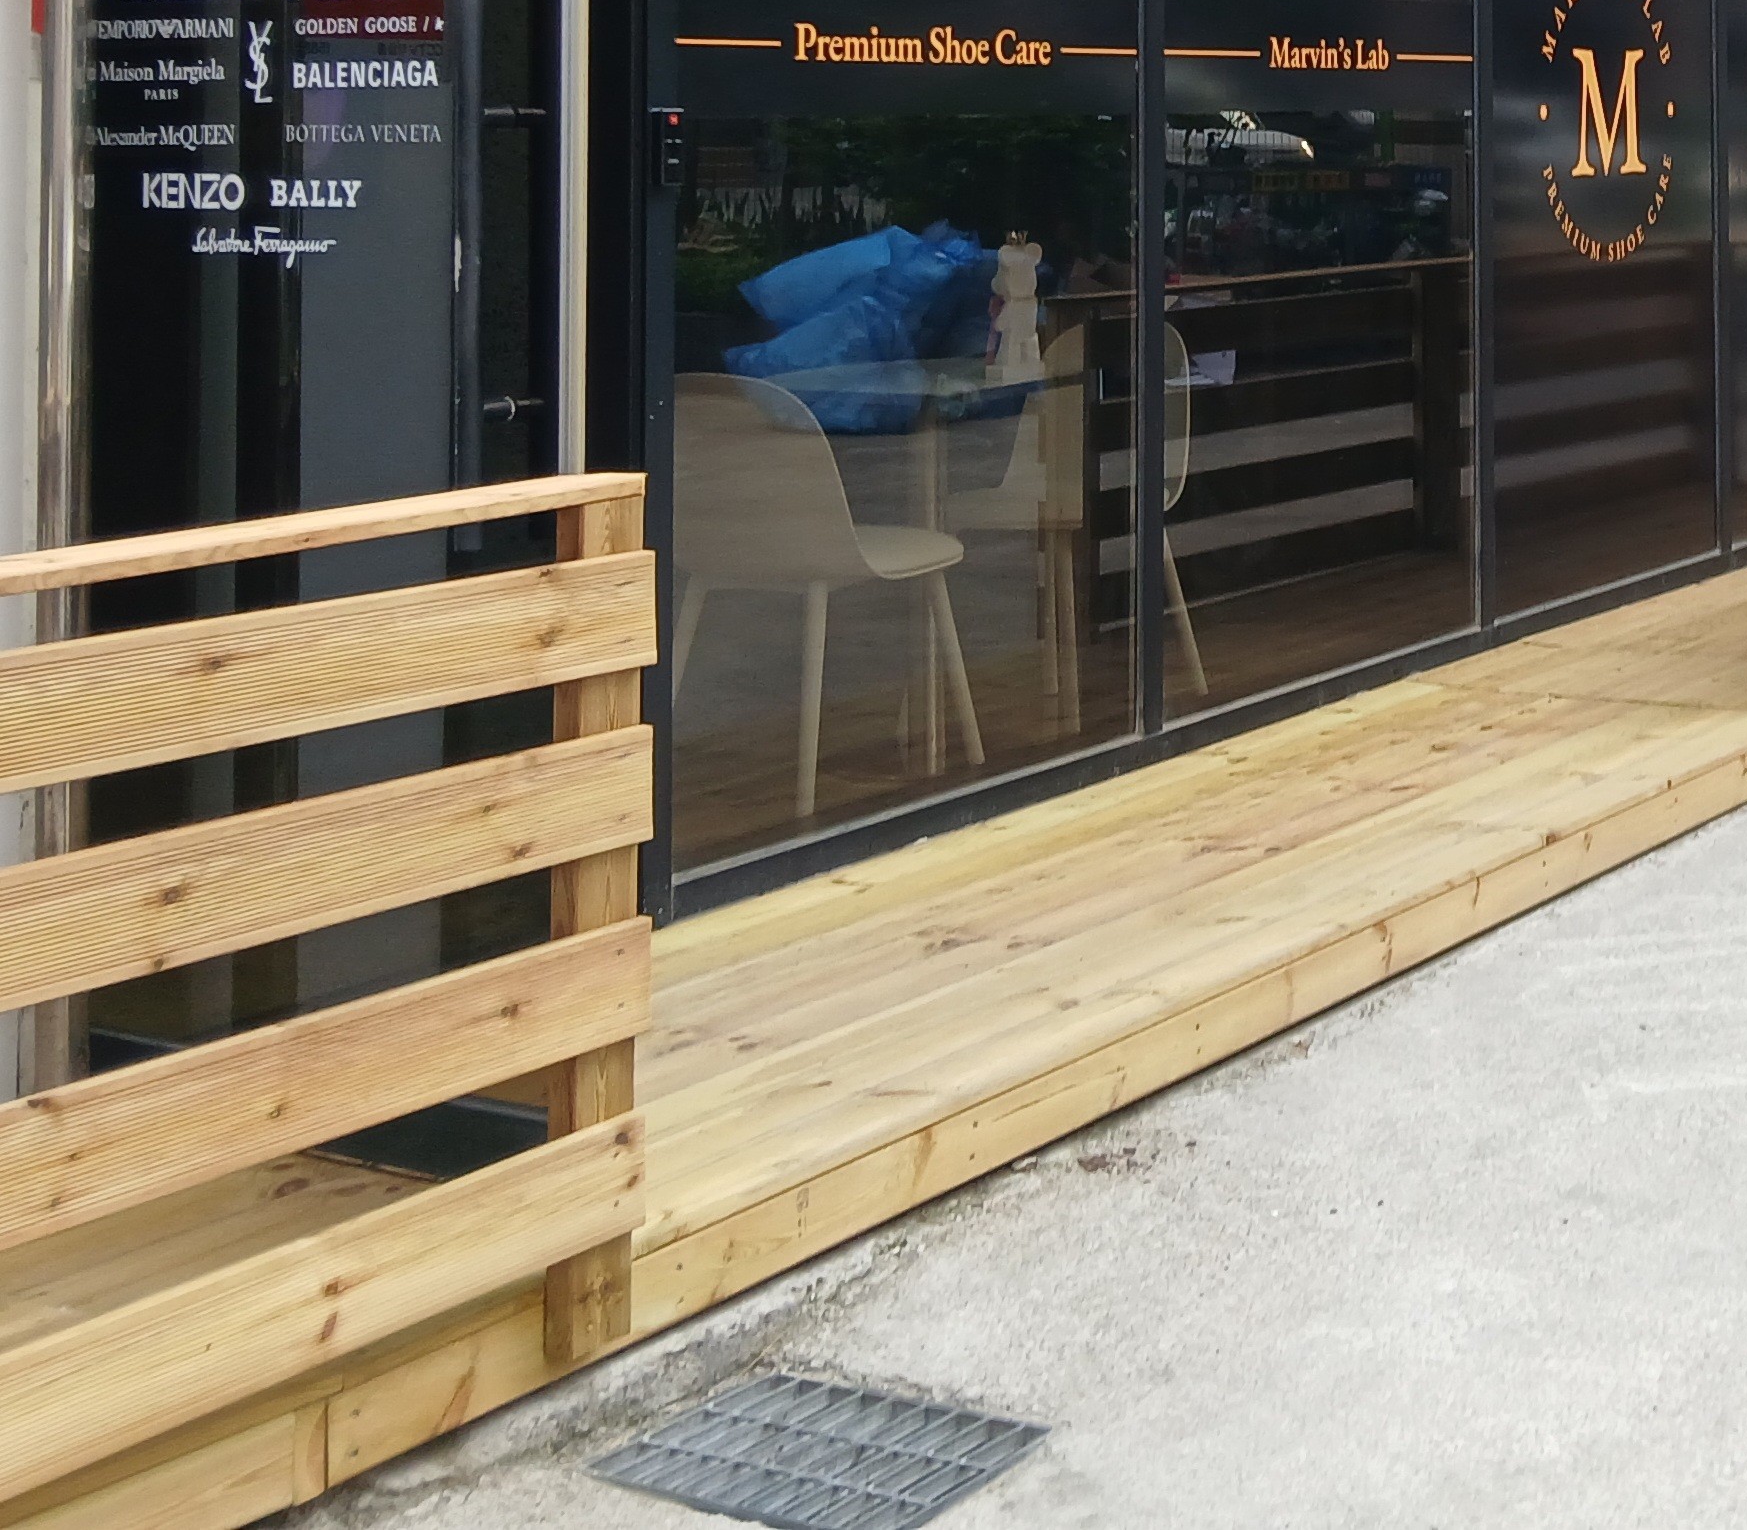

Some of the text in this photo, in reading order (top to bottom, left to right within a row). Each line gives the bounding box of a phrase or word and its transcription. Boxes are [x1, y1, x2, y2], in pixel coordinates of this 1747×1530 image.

[295, 17, 359, 35] GOLDEN
[364, 16, 417, 34] GOOSE
[794, 22, 1052, 66] Premium Shoe Care
[1355, 38, 1389, 70] Lab
[99, 57, 226, 85] Maison Margiela
[292, 60, 439, 89] BALENCIAGA
[143, 88, 179, 101] PARIS
[1571, 48, 1647, 177] M
[285, 123, 442, 143] BOTTEGA VENETA
[142, 172, 362, 211] KENZO BALLY
[1608, 224, 1645, 263] SHOE
